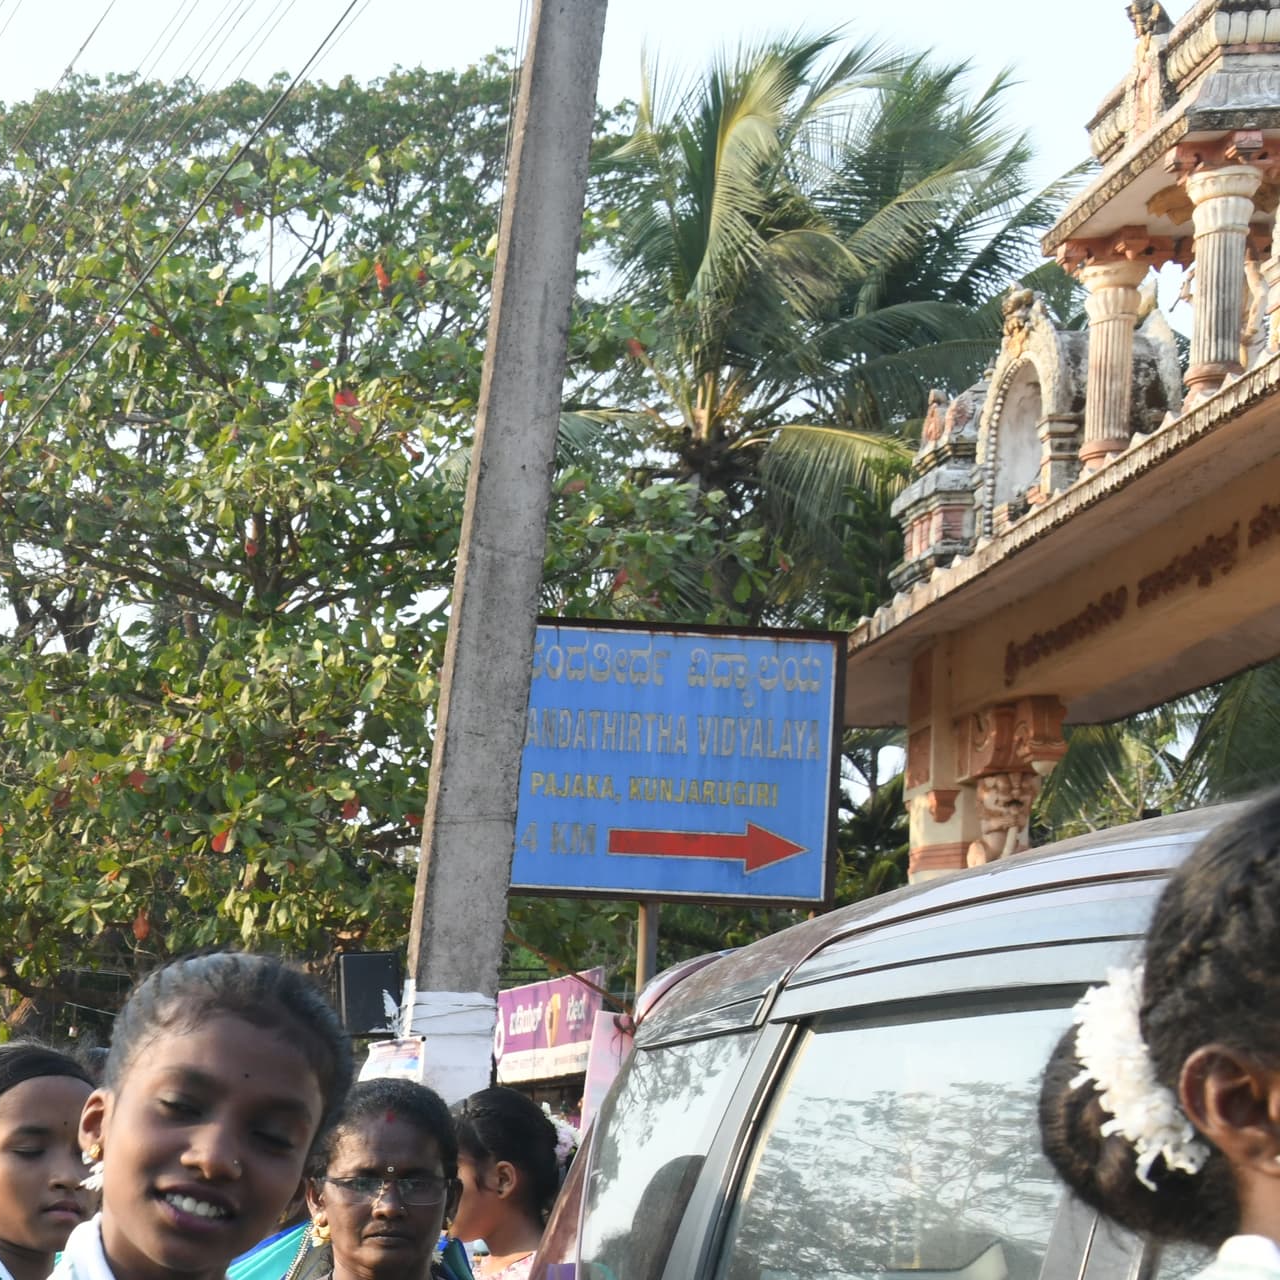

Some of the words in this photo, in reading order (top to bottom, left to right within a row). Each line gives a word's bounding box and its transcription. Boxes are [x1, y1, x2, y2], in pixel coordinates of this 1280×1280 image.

[697, 715, 821, 760] VIDYALAYA
[530, 771, 622, 804] PAJAKA,
[629, 776, 778, 808] KUNJARUGIRI
[550, 822, 597, 856] KM
